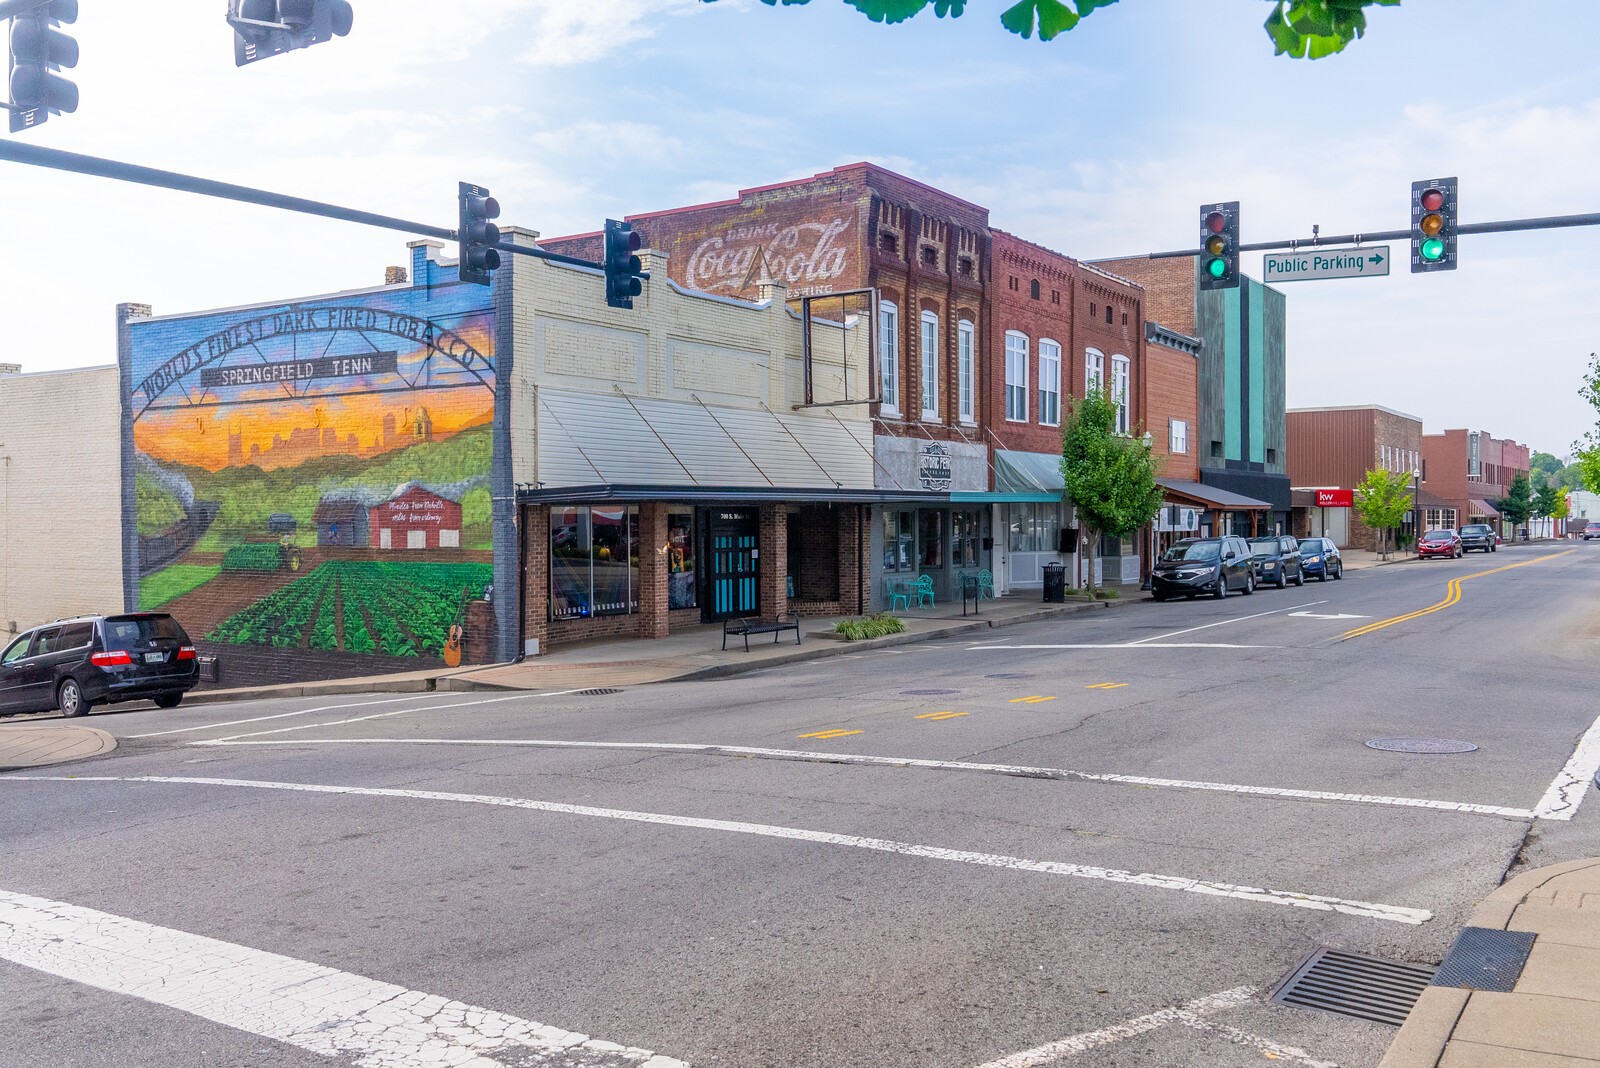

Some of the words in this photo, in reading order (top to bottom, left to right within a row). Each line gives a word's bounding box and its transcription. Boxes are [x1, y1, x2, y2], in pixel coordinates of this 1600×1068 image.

[725, 222, 780, 243] DRINK
[686, 216, 852, 291] CocaCola
[1268, 257, 1308, 273] Public
[1313, 255, 1364, 272] Parking
[786, 284, 833, 299] ESHING
[207, 320, 263, 358] FINEST
[273, 308, 317, 334] DARK
[328, 306, 377, 330] FIRED
[387, 315, 475, 366] TOBACCO
[221, 362, 314, 386] SPRINGFIELD
[332, 357, 372, 376] TENN
[1319, 491, 1334, 501] kw
